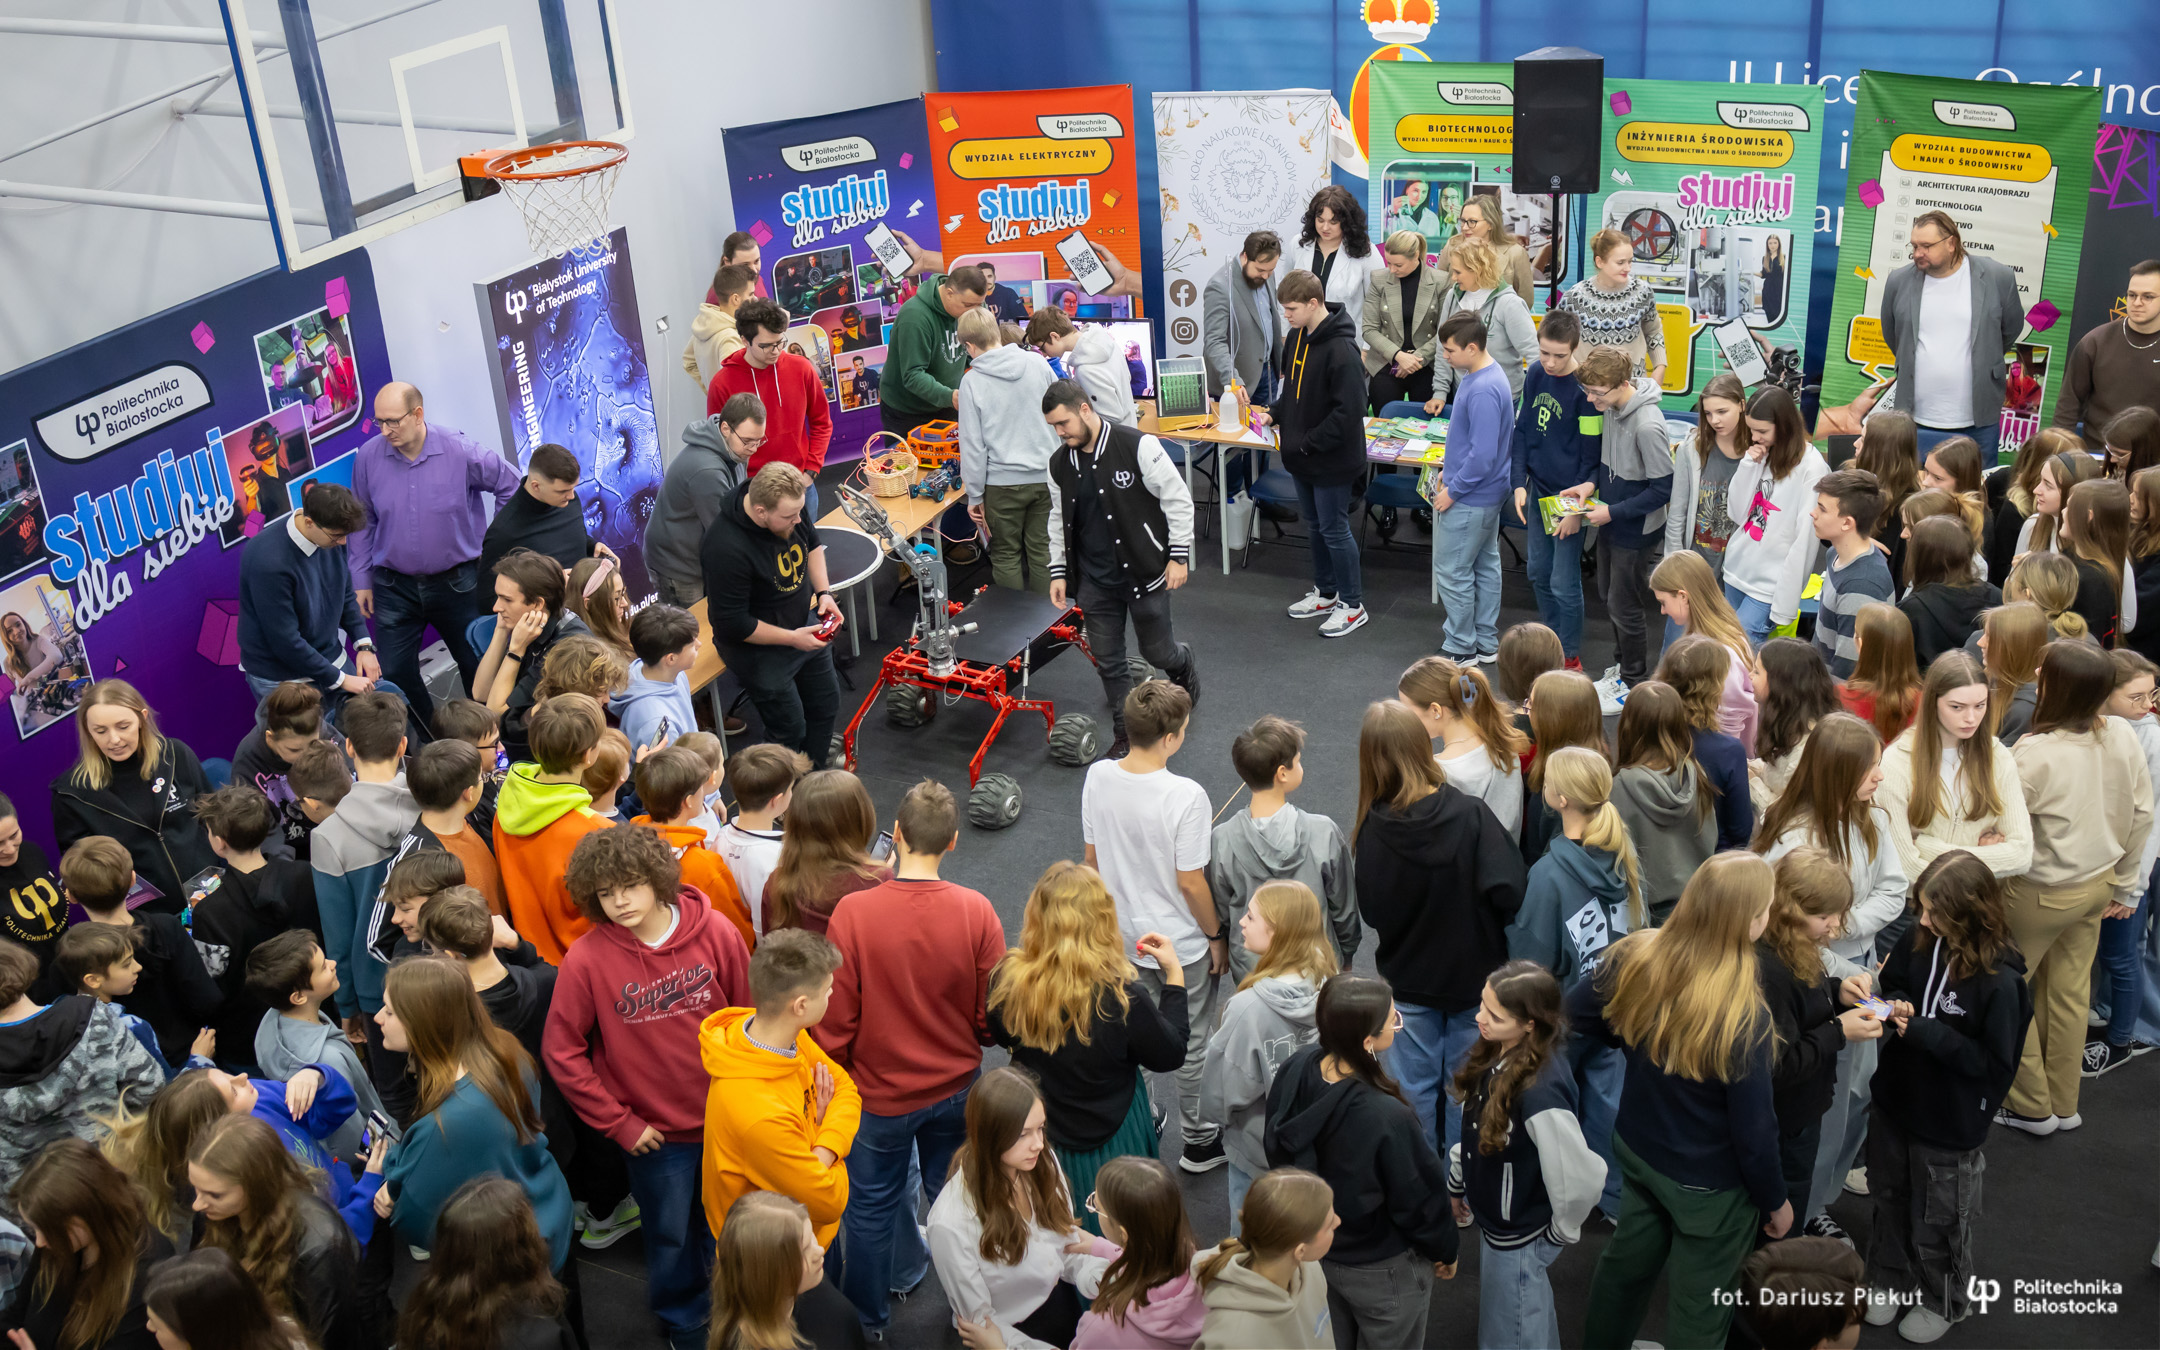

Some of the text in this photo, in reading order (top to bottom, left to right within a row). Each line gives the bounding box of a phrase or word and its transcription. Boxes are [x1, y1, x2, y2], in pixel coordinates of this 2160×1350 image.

[1748, 117, 1793, 125] Białostocka
[1749, 109, 1794, 118] Politechnika
[1963, 109, 1998, 117] Politechnika
[1428, 125, 1513, 134] BIOTECHNOLOG
[1627, 130, 1784, 147] INŻYNIERIA ŚRODOWISKA
[814, 143, 859, 156] Politechnika
[815, 151, 860, 164] Białostocka
[965, 150, 1097, 163] WYDZIAŁ ELEKTRYCZNY
[1201, 126, 1259, 151] NAUKOWE
[1259, 131, 1298, 181] LEŚNIKÓW
[1739, 149, 1783, 158] ŚRODOWISKU
[1914, 142, 2033, 160] WYDZIAŁ BUDOWNICTWA
[1919, 155, 1945, 165] NAUK
[1958, 157, 2023, 172] ŚRODOWISKU
[781, 170, 890, 226] studiuj
[978, 179, 1091, 222] studiuj
[1679, 171, 1795, 221] studiuj
[1917, 180, 2030, 199] ARCHITEKTURA KRAJOBRAZU
[1682, 204, 1717, 230] dla
[1725, 198, 1786, 225] siebie
[1915, 198, 1983, 212] BIOTECHNOLOGIA
[792, 197, 885, 248] dla siebie
[987, 206, 1086, 244] dla siebie
[1962, 240, 1995, 251] CIEPLNA
[532, 251, 617, 298] Bialystok University
[536, 279, 598, 315] of Technology
[101, 378, 180, 420] Politechnika
[513, 341, 541, 453] NGINEERING
[105, 395, 184, 437] Białostocka
[43, 426, 235, 582] studiuj
[75, 492, 234, 630] dla siebie
[4, 915, 53, 942] POLITECHNIKA
